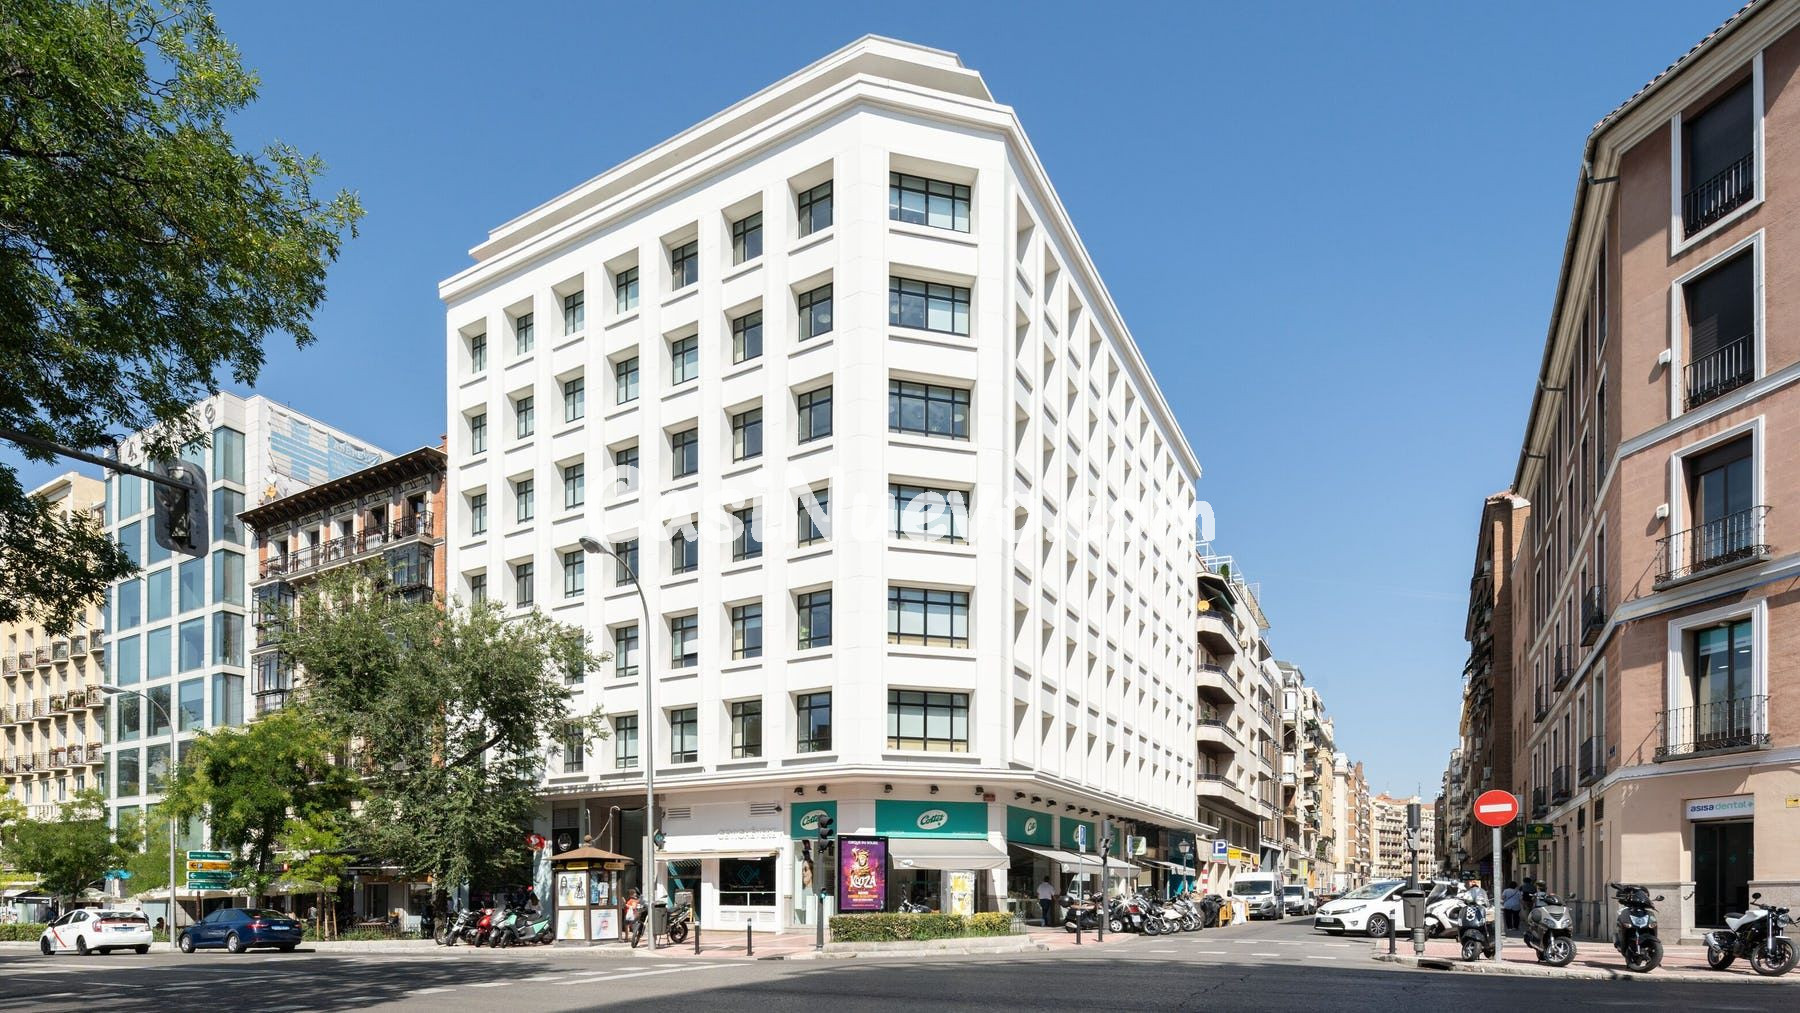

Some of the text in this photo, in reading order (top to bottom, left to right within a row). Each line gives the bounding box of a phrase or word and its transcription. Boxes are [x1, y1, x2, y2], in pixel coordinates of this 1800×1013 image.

[1690, 801, 1748, 812] asisa dental
[1215, 841, 1226, 854] P
